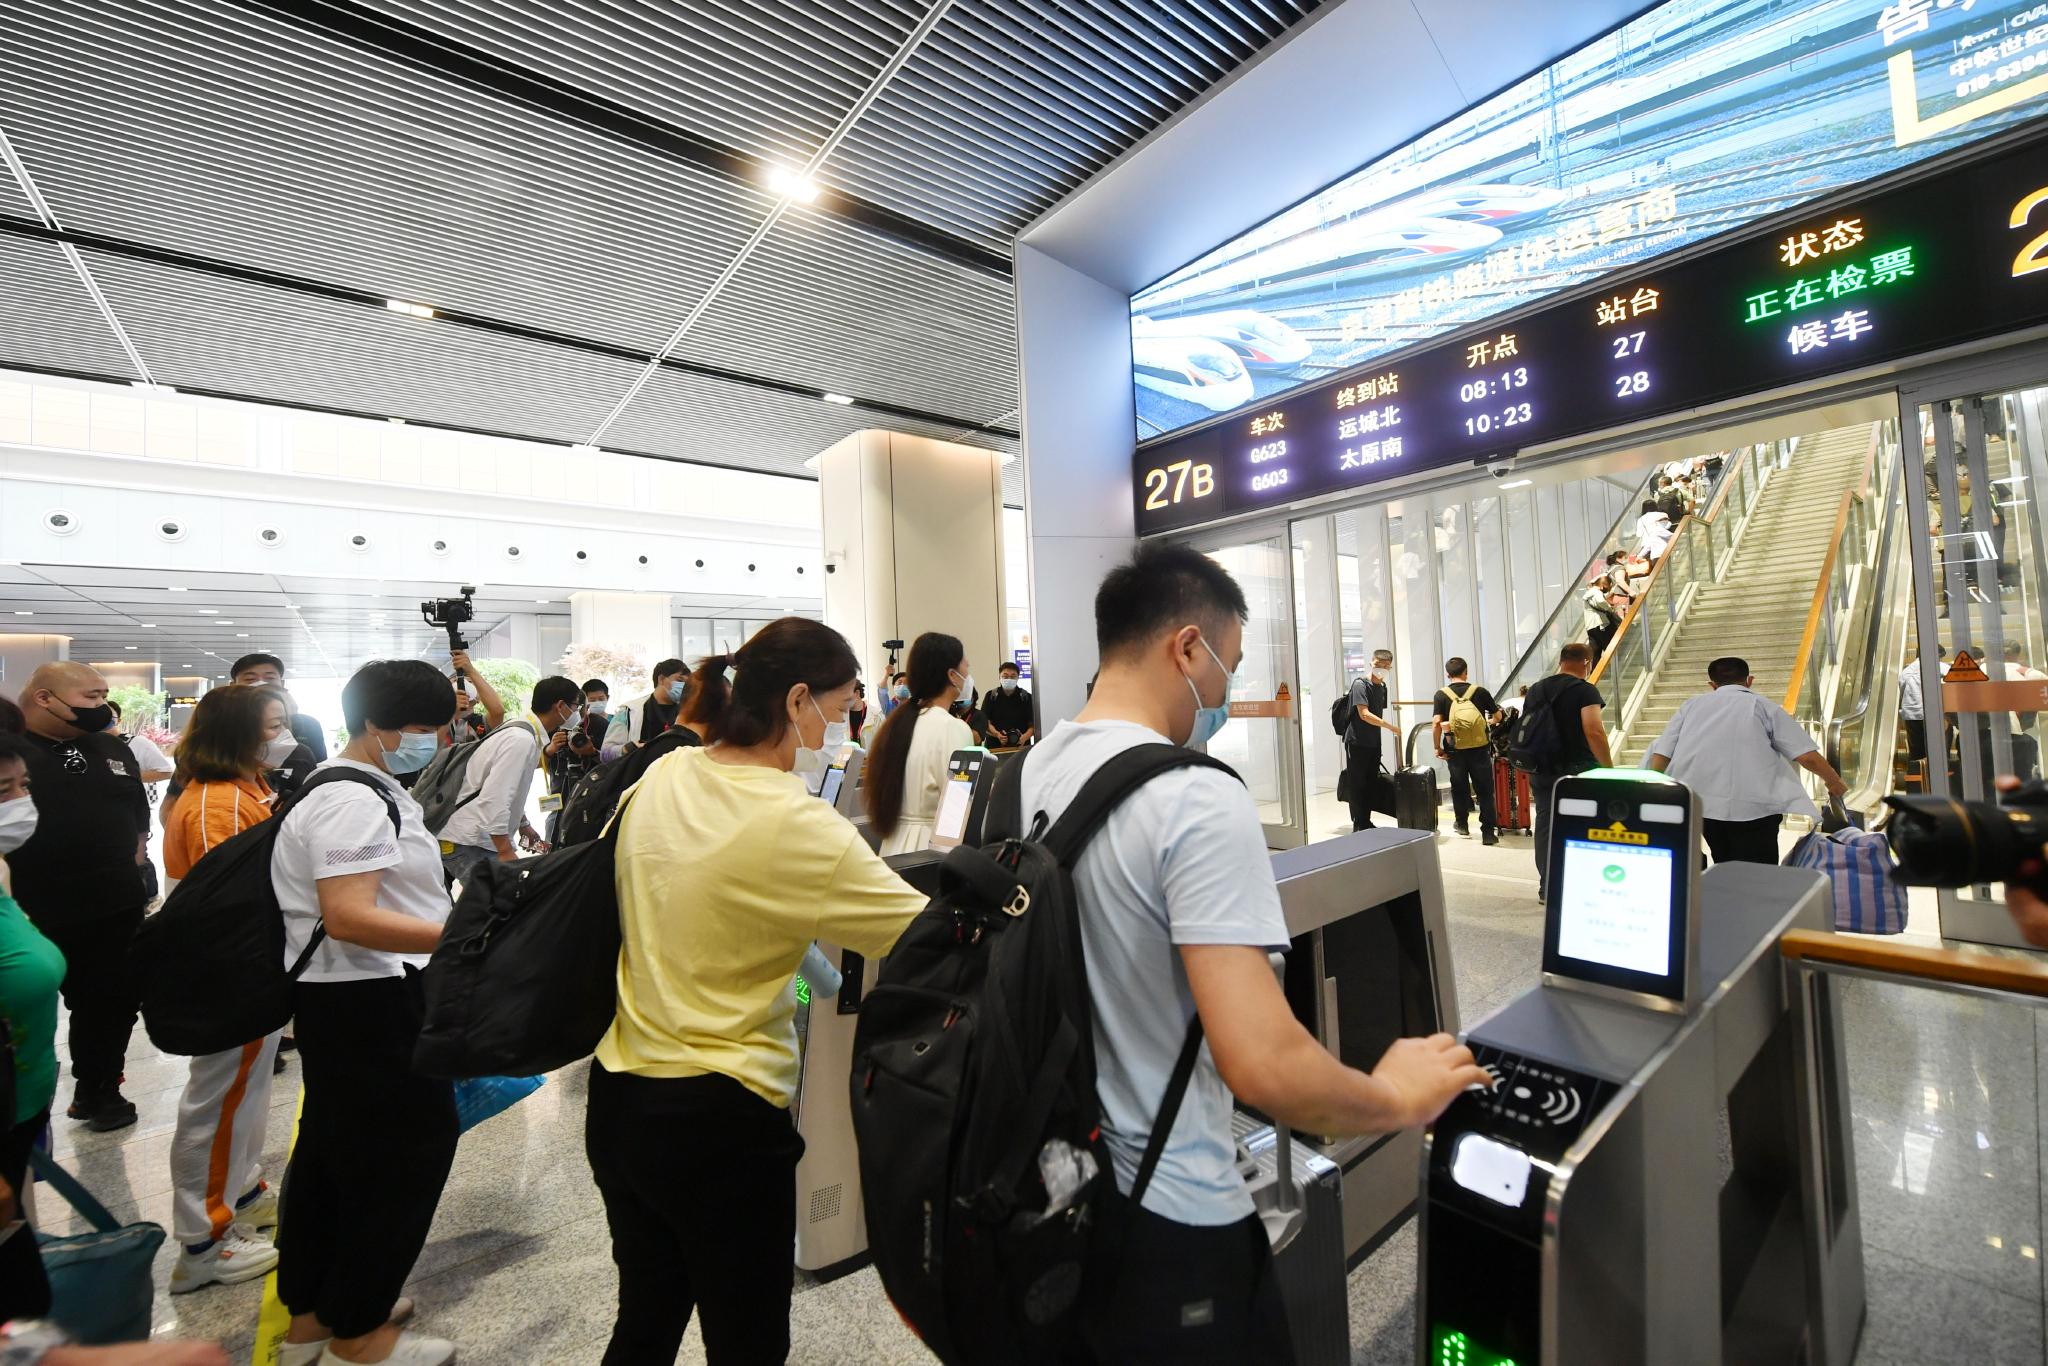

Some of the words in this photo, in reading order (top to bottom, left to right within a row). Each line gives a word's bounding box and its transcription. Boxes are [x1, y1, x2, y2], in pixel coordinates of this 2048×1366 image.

[1645, 225, 1688, 248] REGION
[1779, 218, 1865, 267] 状态
[1744, 246, 1915, 323] 正在检票
[1595, 287, 1660, 326] 站台
[1613, 330, 1647, 359] 27
[1787, 309, 1873, 355] 候车
[1466, 333, 1519, 369] 开点
[1336, 372, 1399, 409] 终到站
[1460, 367, 1529, 403] 08:13
[1615, 370, 1651, 398] 28
[1250, 411, 1285, 436] 车次
[1338, 405, 1402, 440] 运城北
[1465, 402, 1532, 436] 10:23
[1250, 440, 1287, 464] G623
[1340, 436, 1403, 471] 太原南
[1145, 459, 1215, 511] 27B
[1252, 468, 1288, 492] G603
